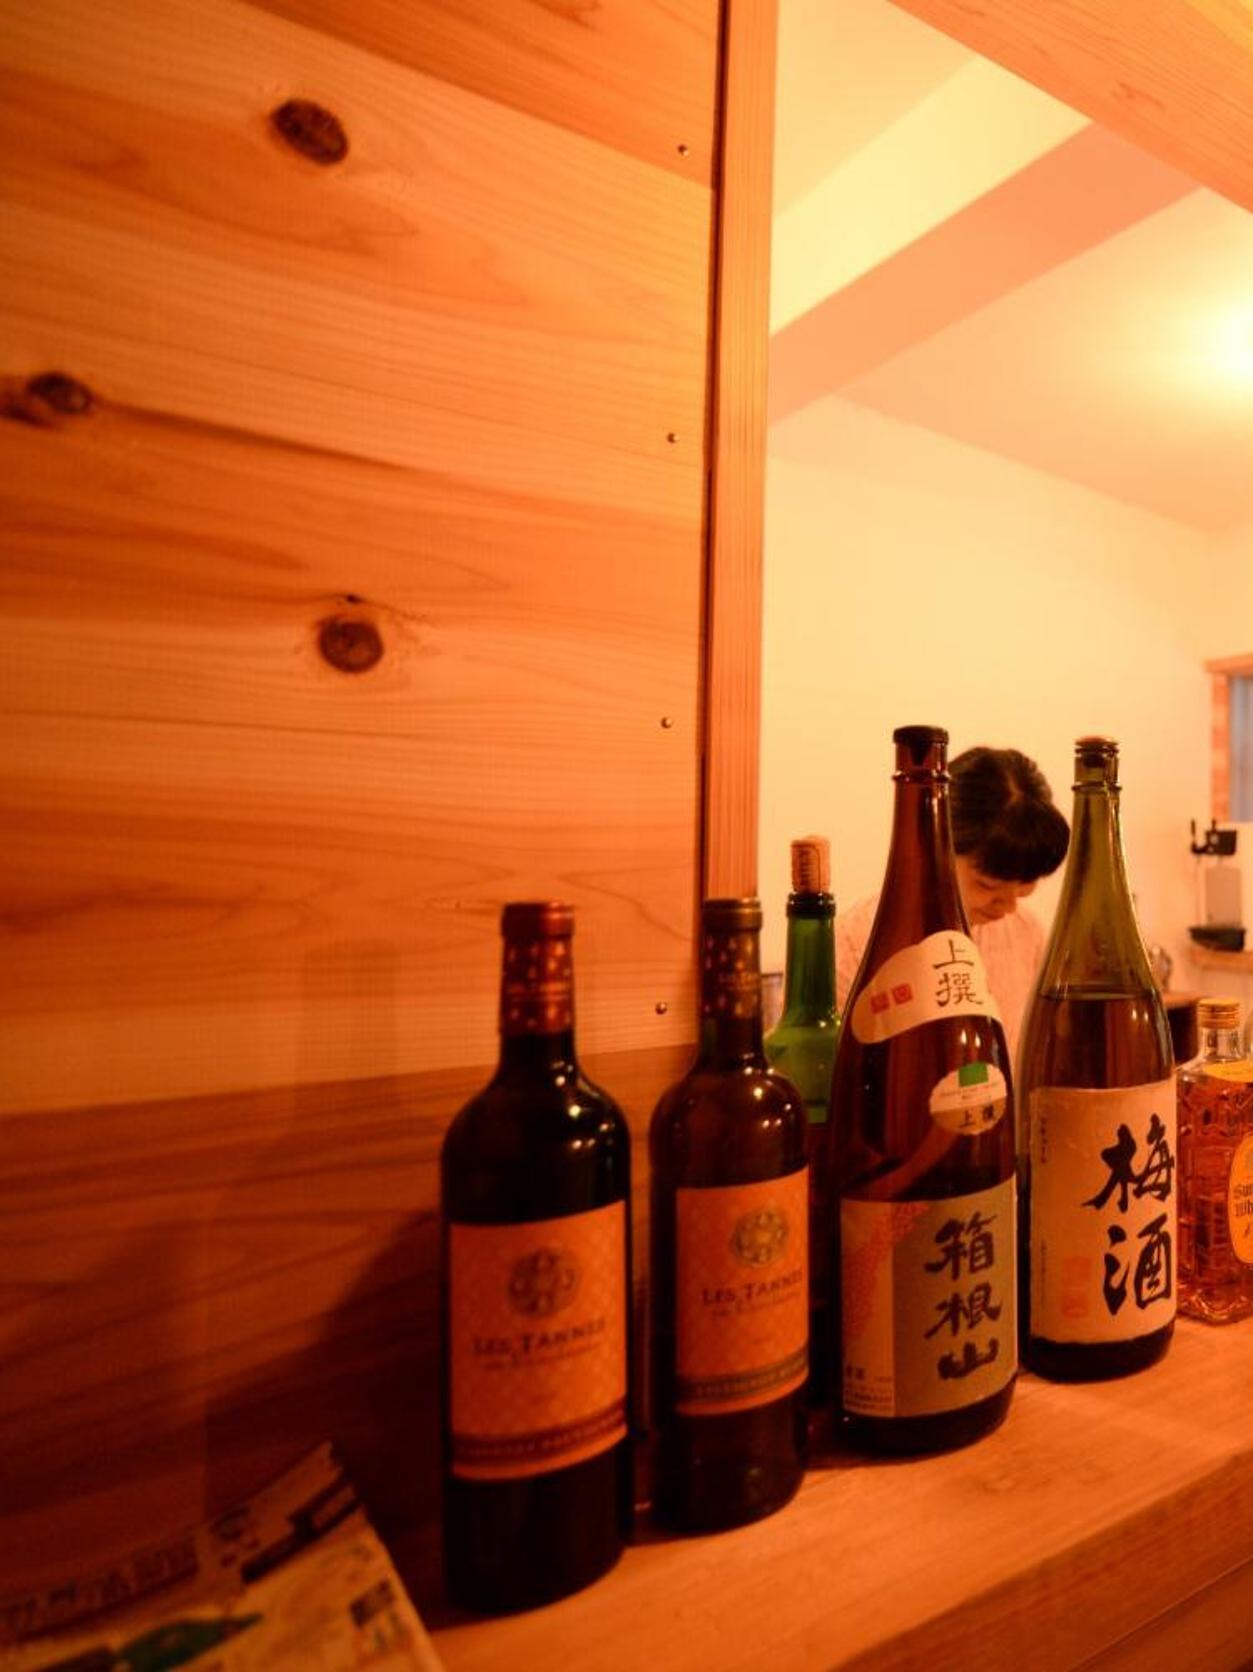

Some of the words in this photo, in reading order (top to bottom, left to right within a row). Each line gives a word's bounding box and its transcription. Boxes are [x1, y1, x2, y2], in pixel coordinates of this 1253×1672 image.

[932, 938, 984, 1008] 上撰
[923, 1211, 1002, 1381] 箱根山
[1081, 1112, 1175, 1317] 梅酒
